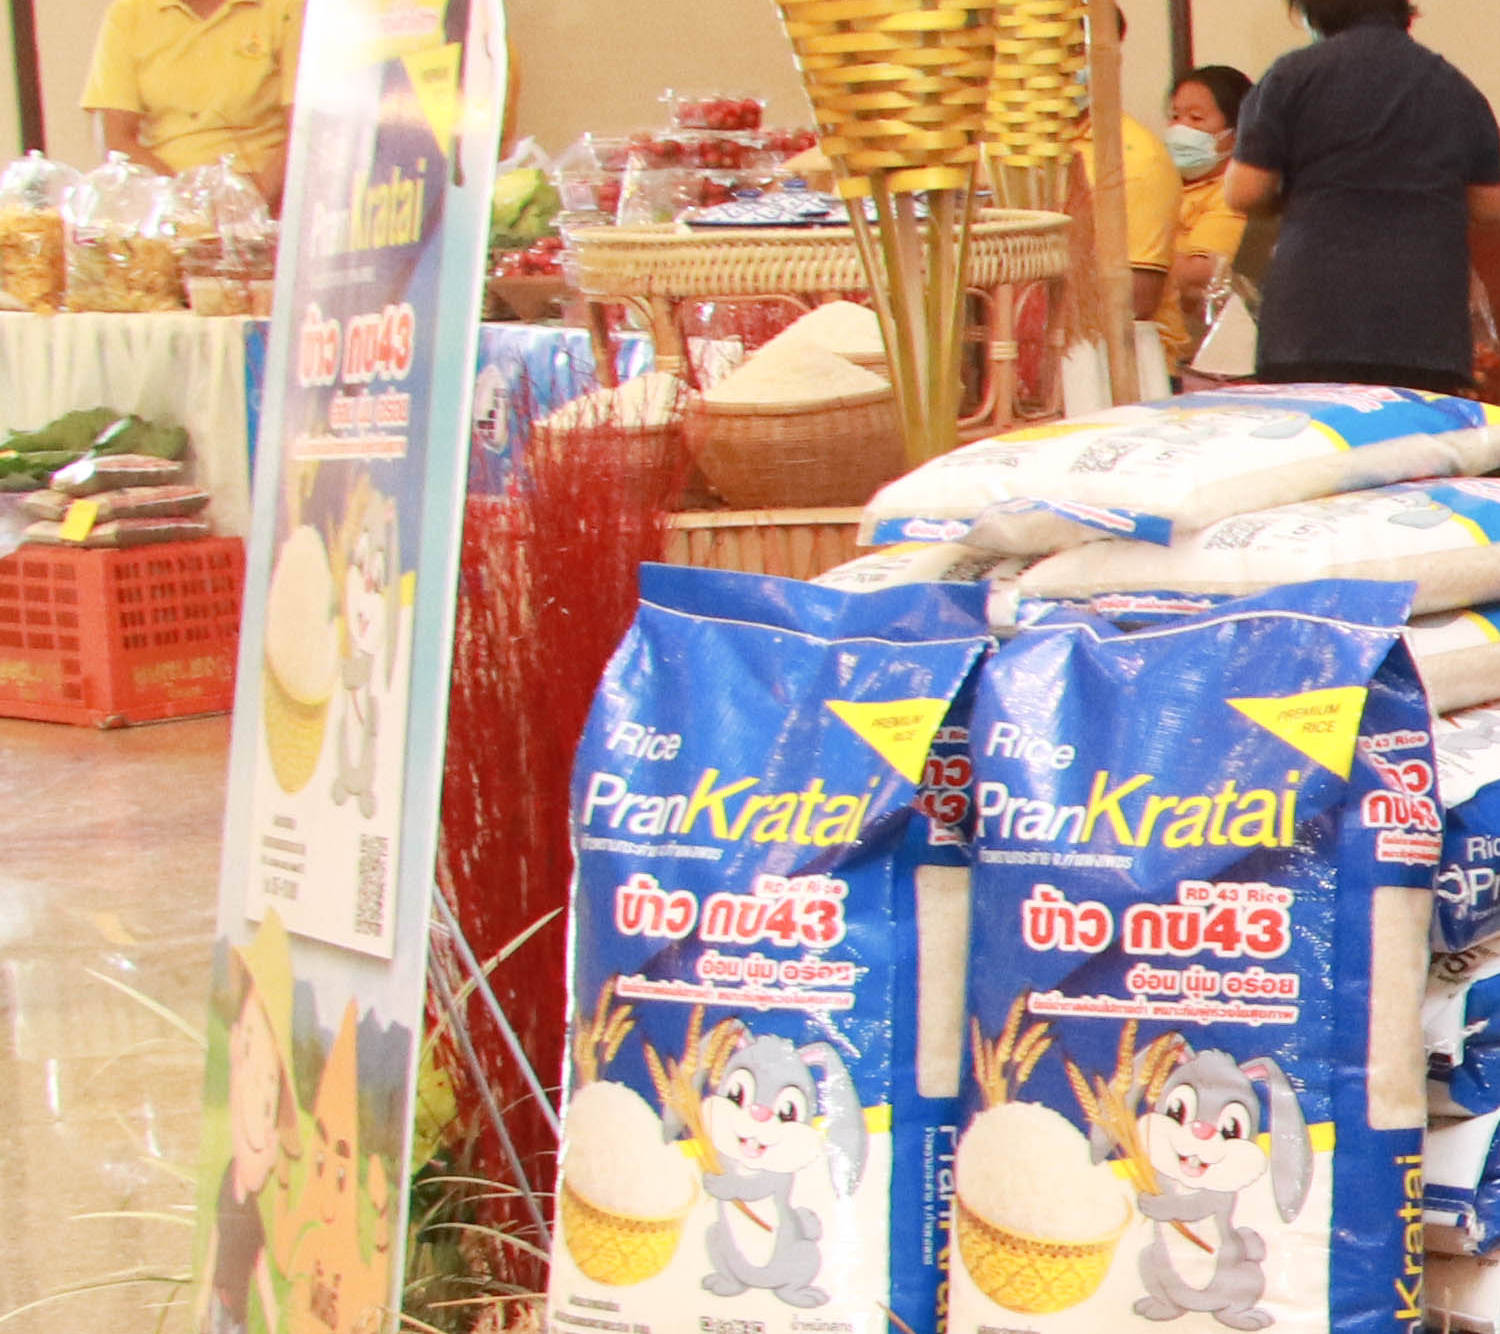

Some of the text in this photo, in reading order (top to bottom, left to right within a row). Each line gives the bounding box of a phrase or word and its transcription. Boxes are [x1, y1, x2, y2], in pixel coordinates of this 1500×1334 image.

[345, 308, 413, 377] กข43
[607, 720, 683, 761] Rice
[984, 721, 1076, 770] Rice
[1301, 720, 1337, 735] RICE
[976, 770, 1300, 848] PranKratai
[620, 878, 840, 943] ข้าว กข43
[1185, 887, 1289, 904] RD 43 Rice
[1029, 890, 1285, 954] ข้าว กข43
[745, 954, 774, 986] นุ่ม
[1131, 966, 1295, 998] อ่อน นุ่ม อร่อย
